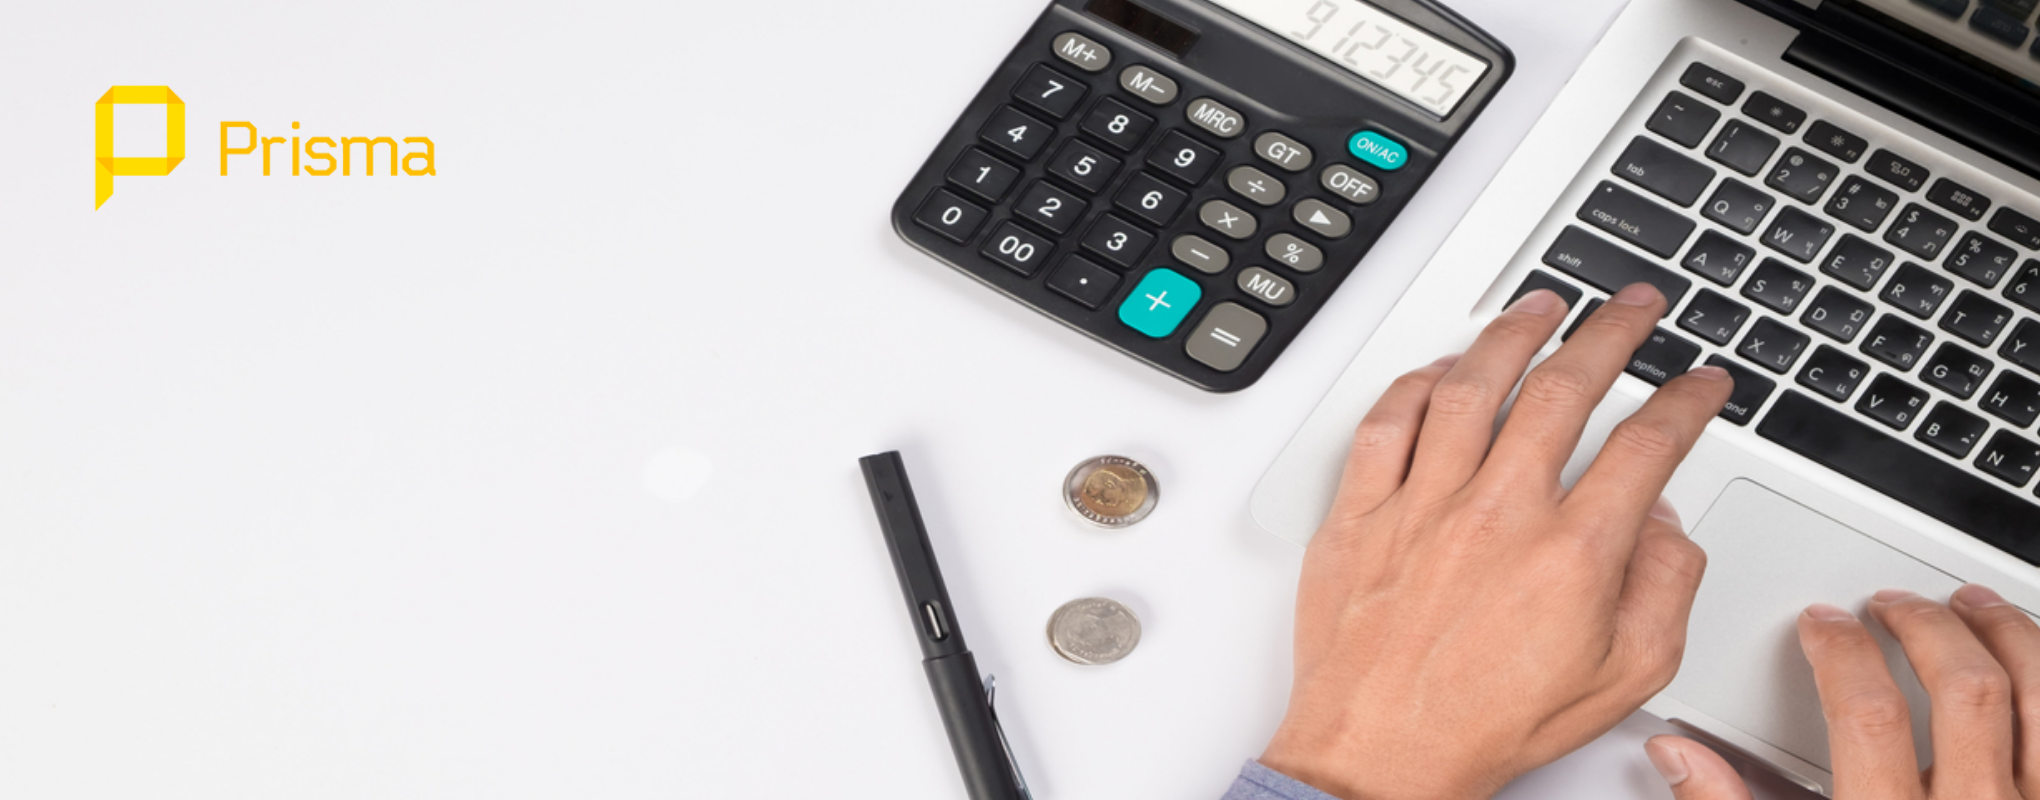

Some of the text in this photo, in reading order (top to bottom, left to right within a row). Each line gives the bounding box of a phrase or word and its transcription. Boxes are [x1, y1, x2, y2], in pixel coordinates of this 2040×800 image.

[1061, 37, 1097, 62] M+
[1041, 79, 1064, 98] 7
[1705, 76, 1724, 89] esc
[1107, 114, 1130, 134] 8
[1193, 102, 1237, 134] MRC
[1007, 125, 1028, 143] 4
[1267, 141, 1302, 164] GT
[1356, 137, 1400, 164] ON/AC
[1719, 140, 1729, 153] 1
[1073, 155, 1097, 176] 5
[1173, 148, 1196, 168] 9
[976, 166, 991, 183] 1
[1626, 163, 1645, 177] tab
[1776, 169, 1791, 182] 2
[1329, 171, 1373, 198] OFF
[1848, 183, 1861, 195] #
[1038, 197, 1062, 218] 2
[1141, 190, 1163, 210] 6
[1713, 200, 1730, 216] Q
[1836, 197, 1849, 210] 3
[941, 206, 963, 225] 0
[1592, 208, 1640, 236] caps lock
[1907, 211, 1920, 223] $
[1106, 231, 1128, 251] 3
[1773, 227, 1794, 244] W
[1897, 226, 1910, 239] 4
[999, 235, 1035, 262] 00
[1282, 243, 1304, 264] %
[1557, 253, 1583, 268] shift
[1692, 252, 1708, 267] A
[1830, 255, 1845, 270] E
[1955, 254, 1970, 267] 5
[1245, 271, 1287, 301] MU
[1752, 279, 1767, 293] S
[1890, 283, 1906, 298] R
[2015, 282, 2028, 295] 6
[1145, 290, 1172, 311] +
[1687, 310, 1705, 326] Z
[1811, 307, 1828, 322] D
[1953, 311, 1967, 325] T
[1210, 327, 1241, 347] =
[1747, 337, 1765, 354] X
[1871, 335, 1886, 348] F
[2013, 339, 2027, 353] Y
[1633, 358, 1667, 379] option
[1808, 367, 1824, 382] C
[1932, 364, 1949, 379] G
[1869, 394, 1884, 409] V
[1990, 391, 2009, 408] H
[1926, 422, 1941, 437] B
[1986, 450, 2005, 467] N
